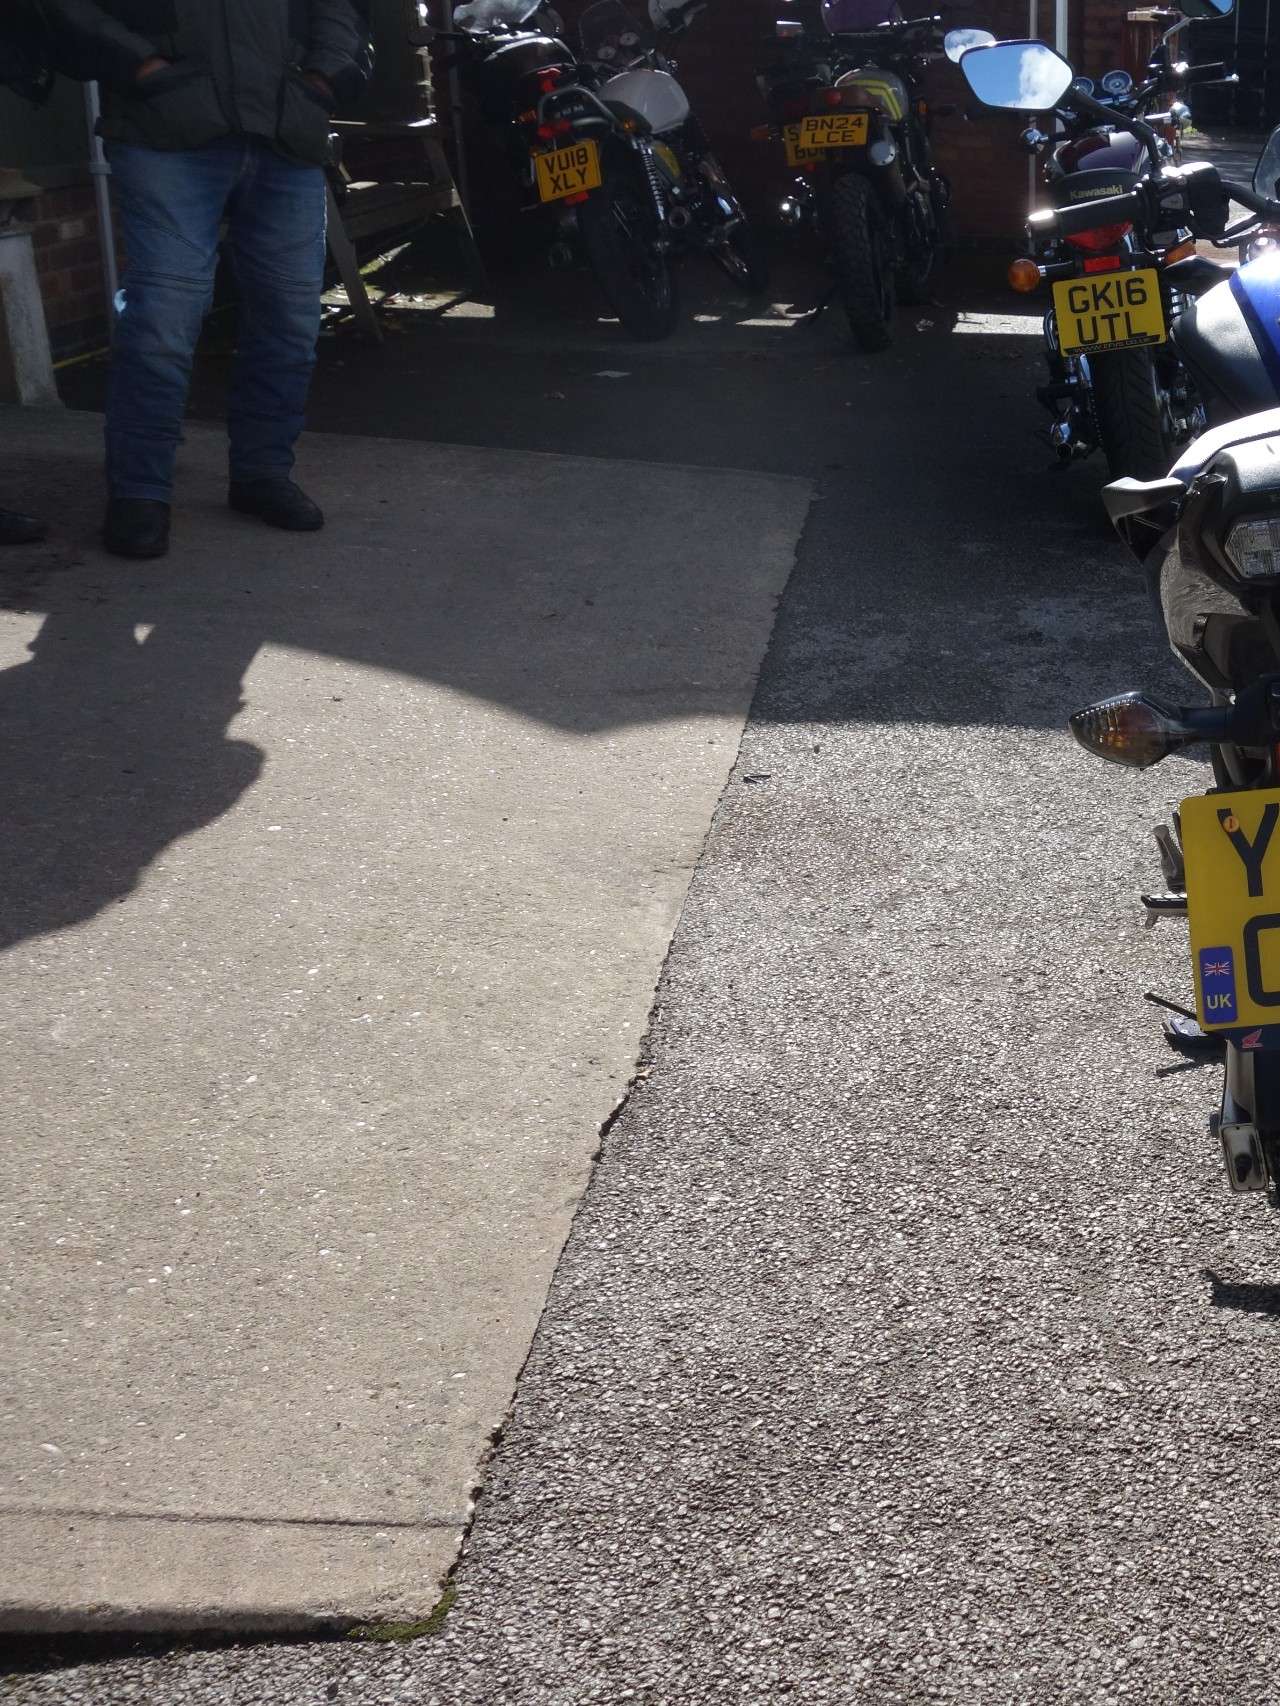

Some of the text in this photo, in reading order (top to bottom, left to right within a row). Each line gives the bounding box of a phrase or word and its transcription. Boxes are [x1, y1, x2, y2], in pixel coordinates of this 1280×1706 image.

[806, 116, 864, 131] BN24
[811, 129, 857, 144] LCE
[544, 147, 588, 174] VU18
[550, 167, 586, 194] XLY
[1070, 184, 1123, 200] Kawasaki
[1068, 277, 1147, 314] GK16
[1076, 312, 1148, 344] UTL
[1206, 993, 1233, 1010] UK
